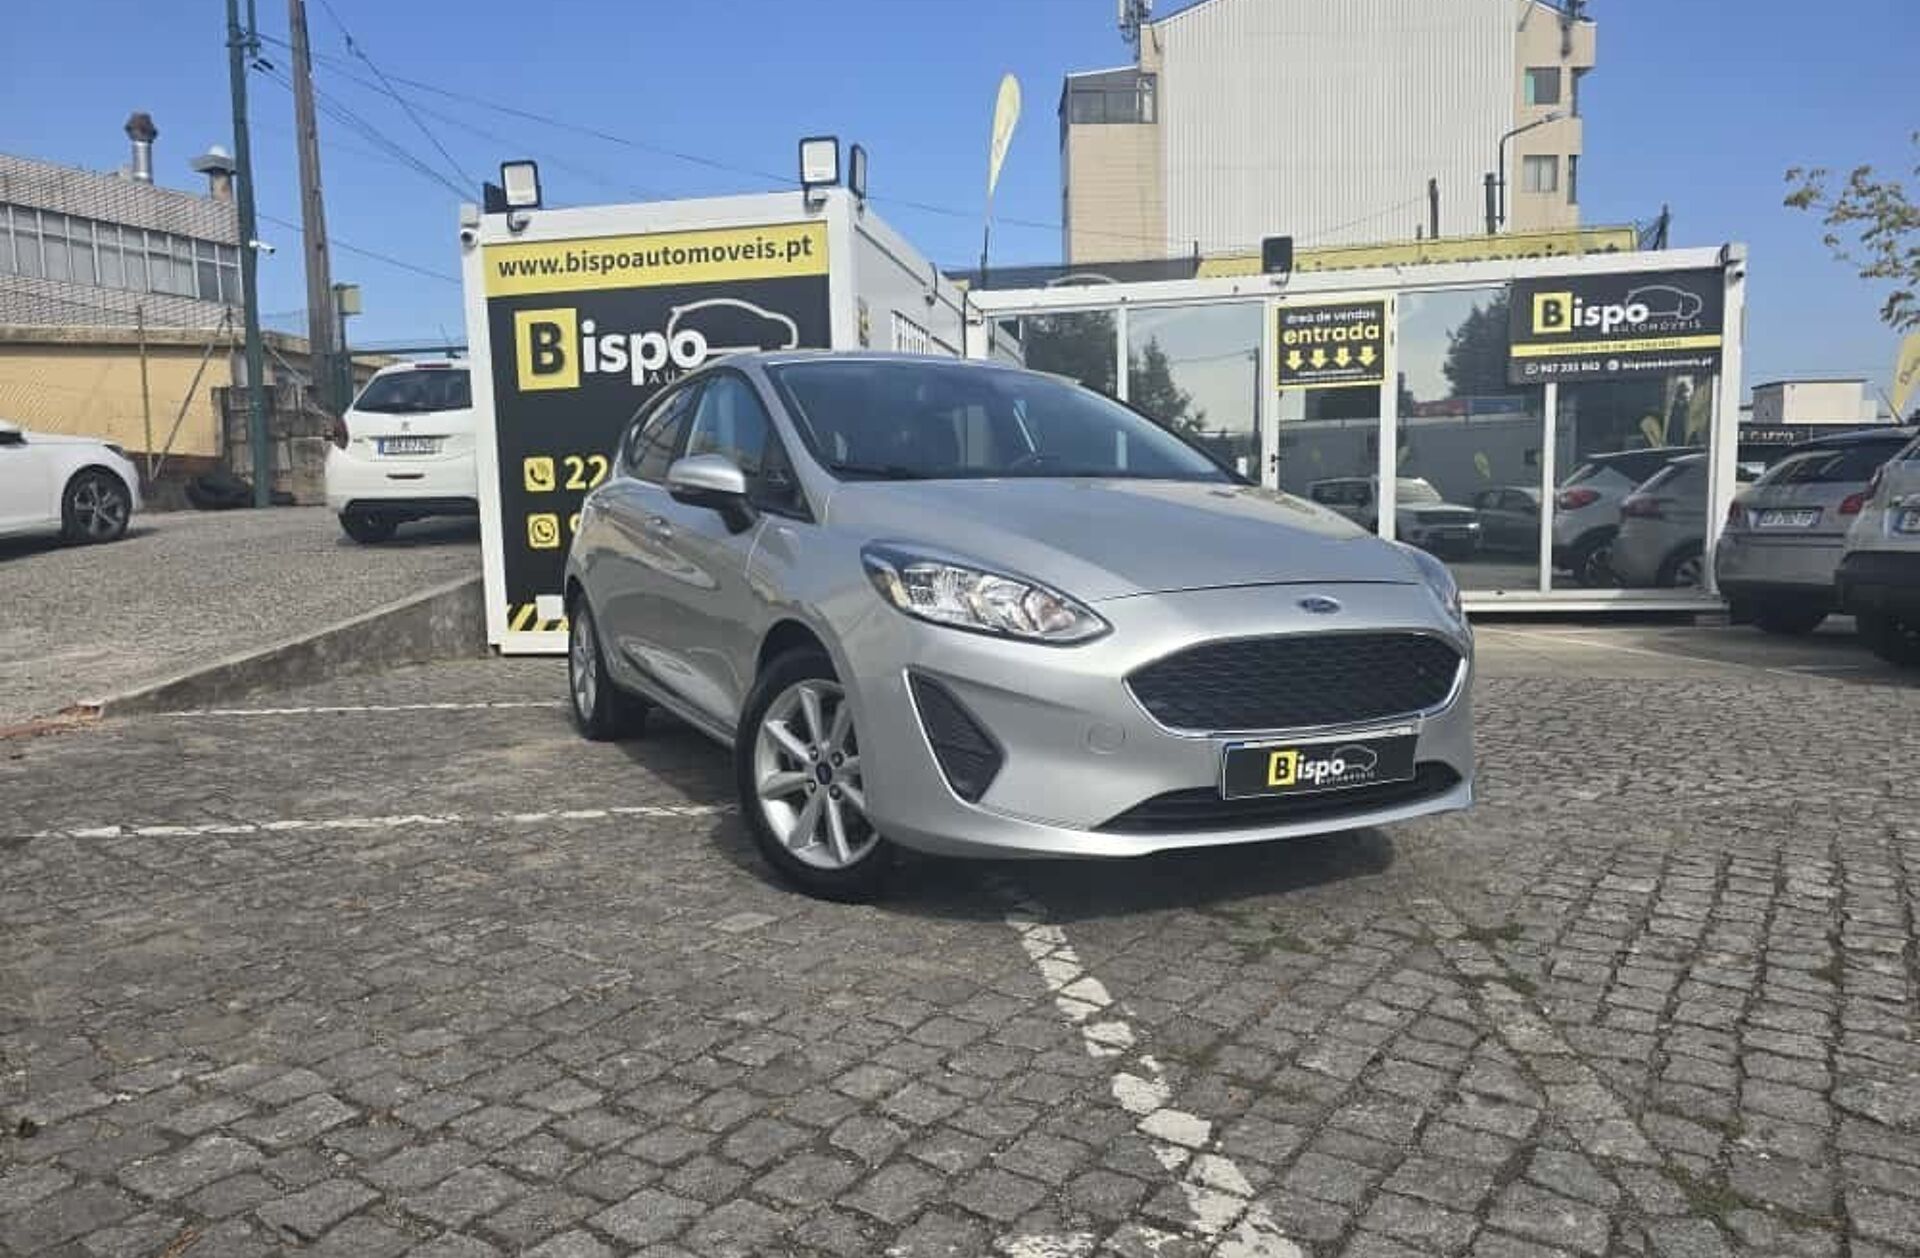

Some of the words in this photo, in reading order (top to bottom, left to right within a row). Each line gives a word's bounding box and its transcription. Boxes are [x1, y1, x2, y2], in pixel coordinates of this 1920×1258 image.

[498, 236, 813, 277] www.bispoautomoveis.pt
[1283, 321, 1380, 345] entrada
[1541, 296, 1650, 334] Bispo
[526, 319, 708, 386] Bispo
[1274, 754, 1345, 785] Bispo
